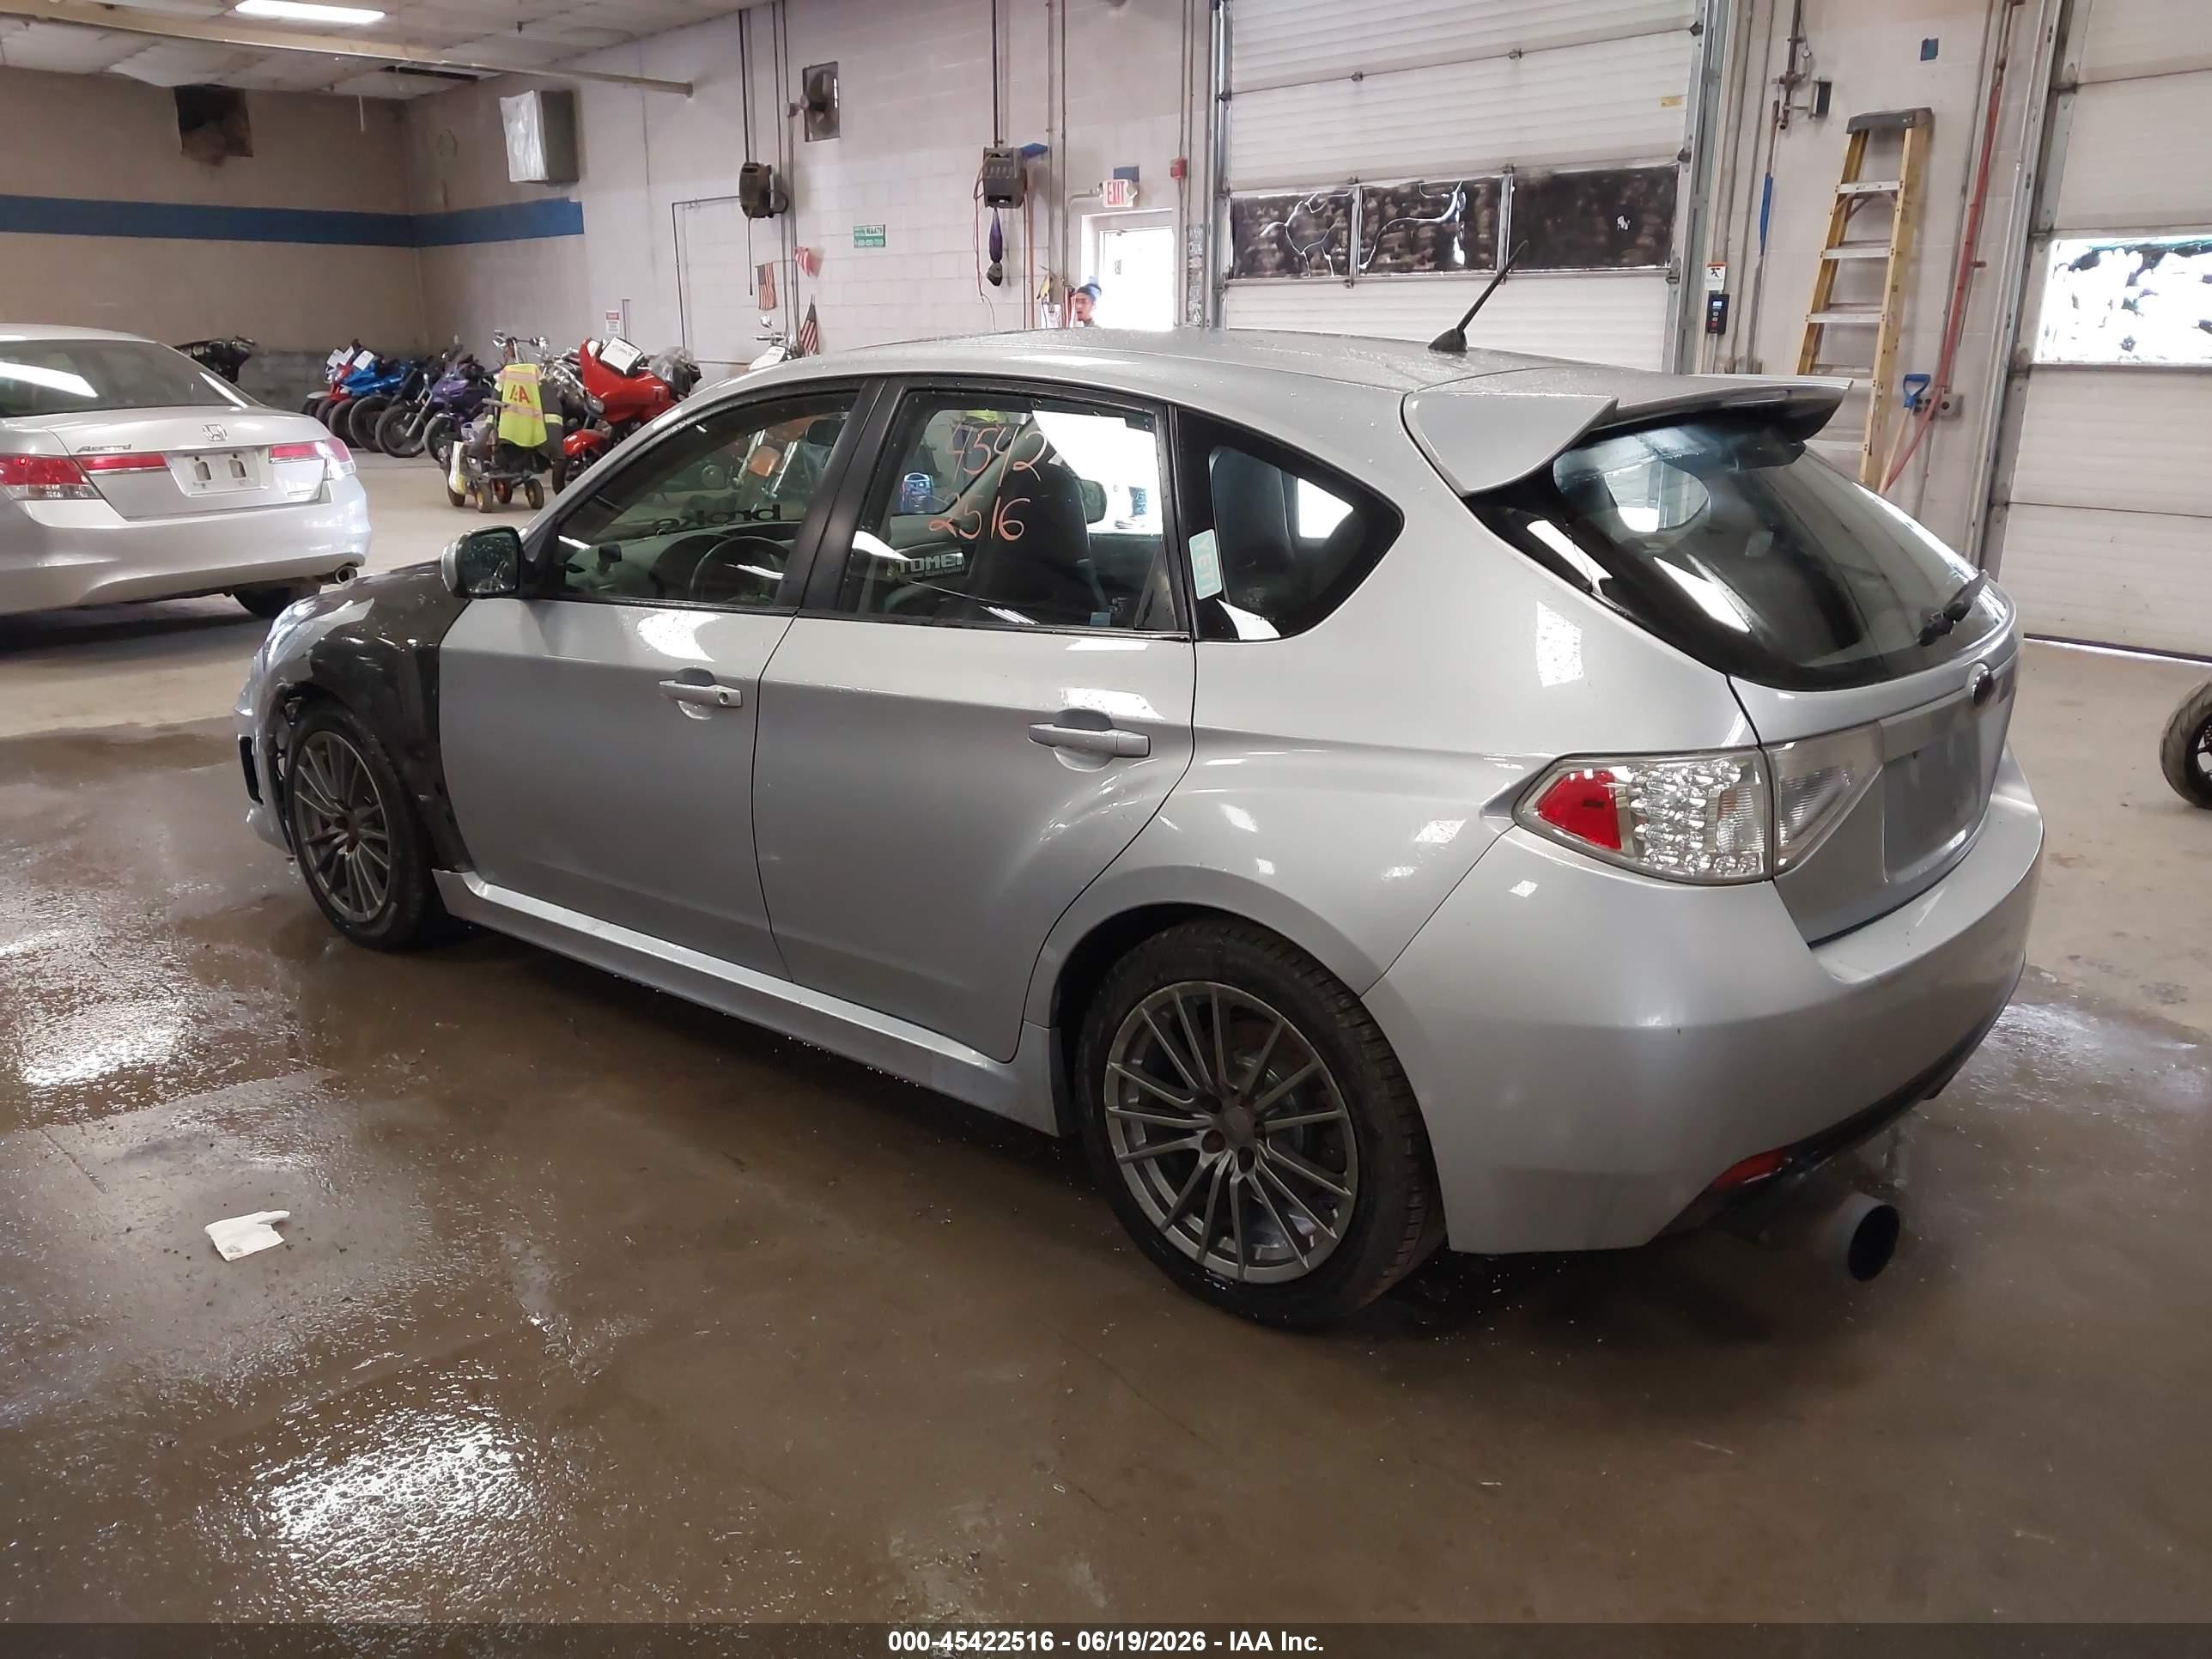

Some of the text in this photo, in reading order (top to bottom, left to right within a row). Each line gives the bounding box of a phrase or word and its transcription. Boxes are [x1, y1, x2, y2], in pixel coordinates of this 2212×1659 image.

[1107, 180, 1126, 204] EXIT
[929, 493, 1030, 541] 2516
[896, 552, 963, 573] TOMEI
[1194, 535, 1215, 592] YETI
